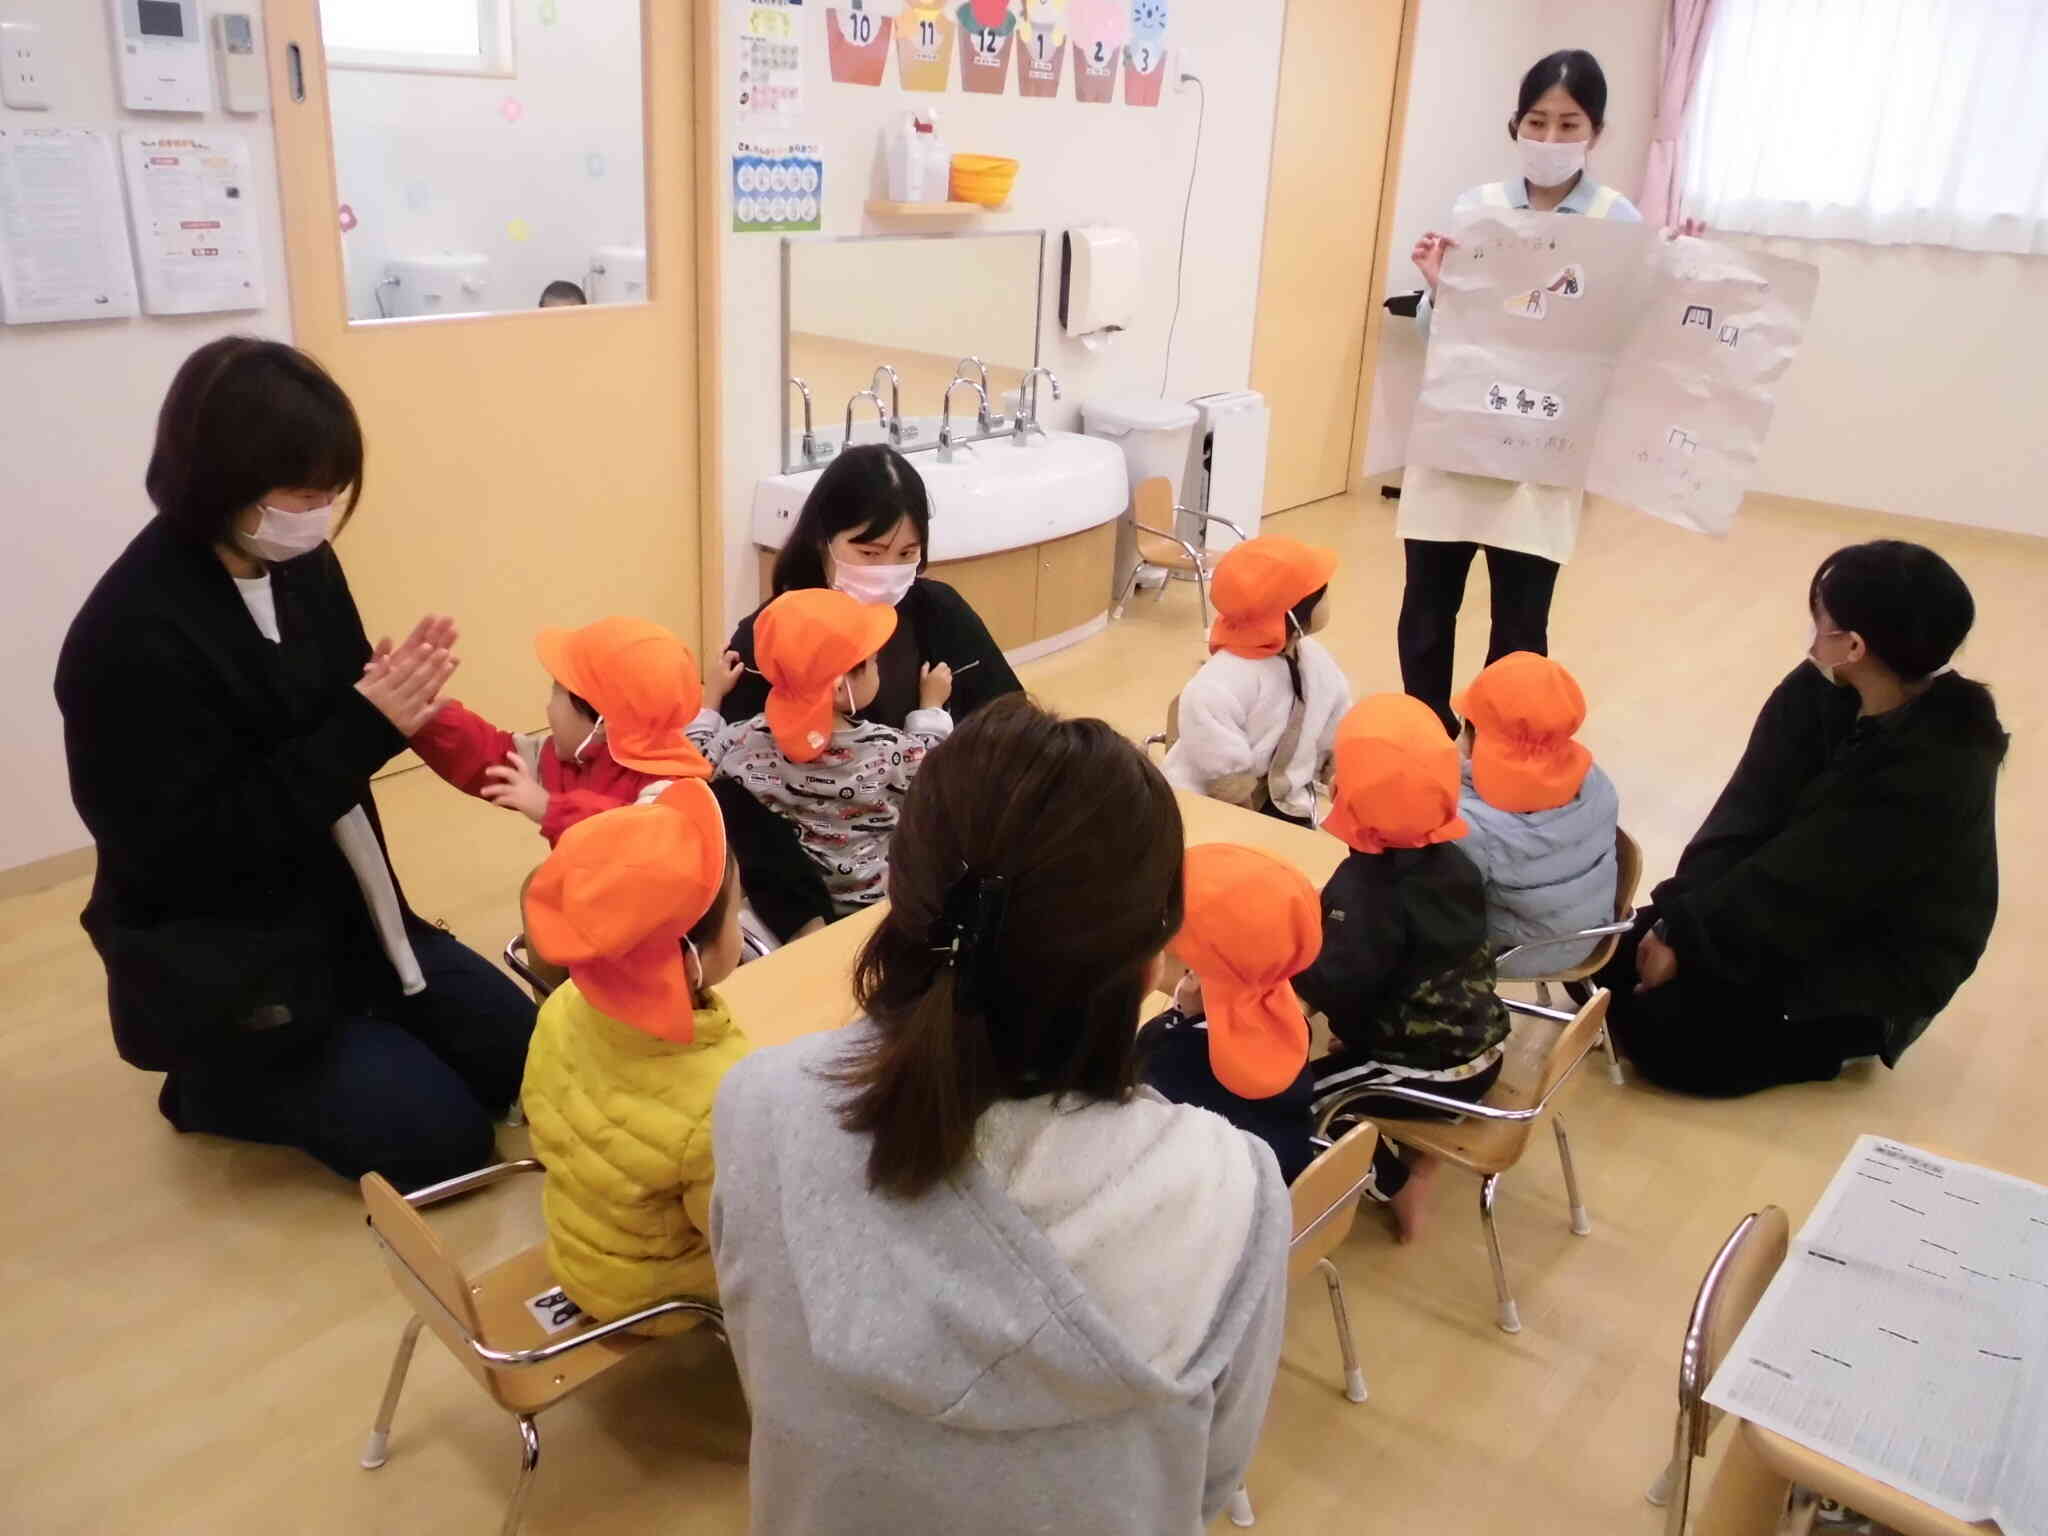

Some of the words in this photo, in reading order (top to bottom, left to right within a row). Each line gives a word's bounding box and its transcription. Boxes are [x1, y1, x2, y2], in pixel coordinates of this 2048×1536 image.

[850, 13, 870, 43] 10
[919, 20, 934, 46] 11
[980, 29, 997, 53] 12
[1037, 33, 1044, 60] 1
[1094, 41, 1104, 63] 2
[1141, 48, 1150, 72] 3
